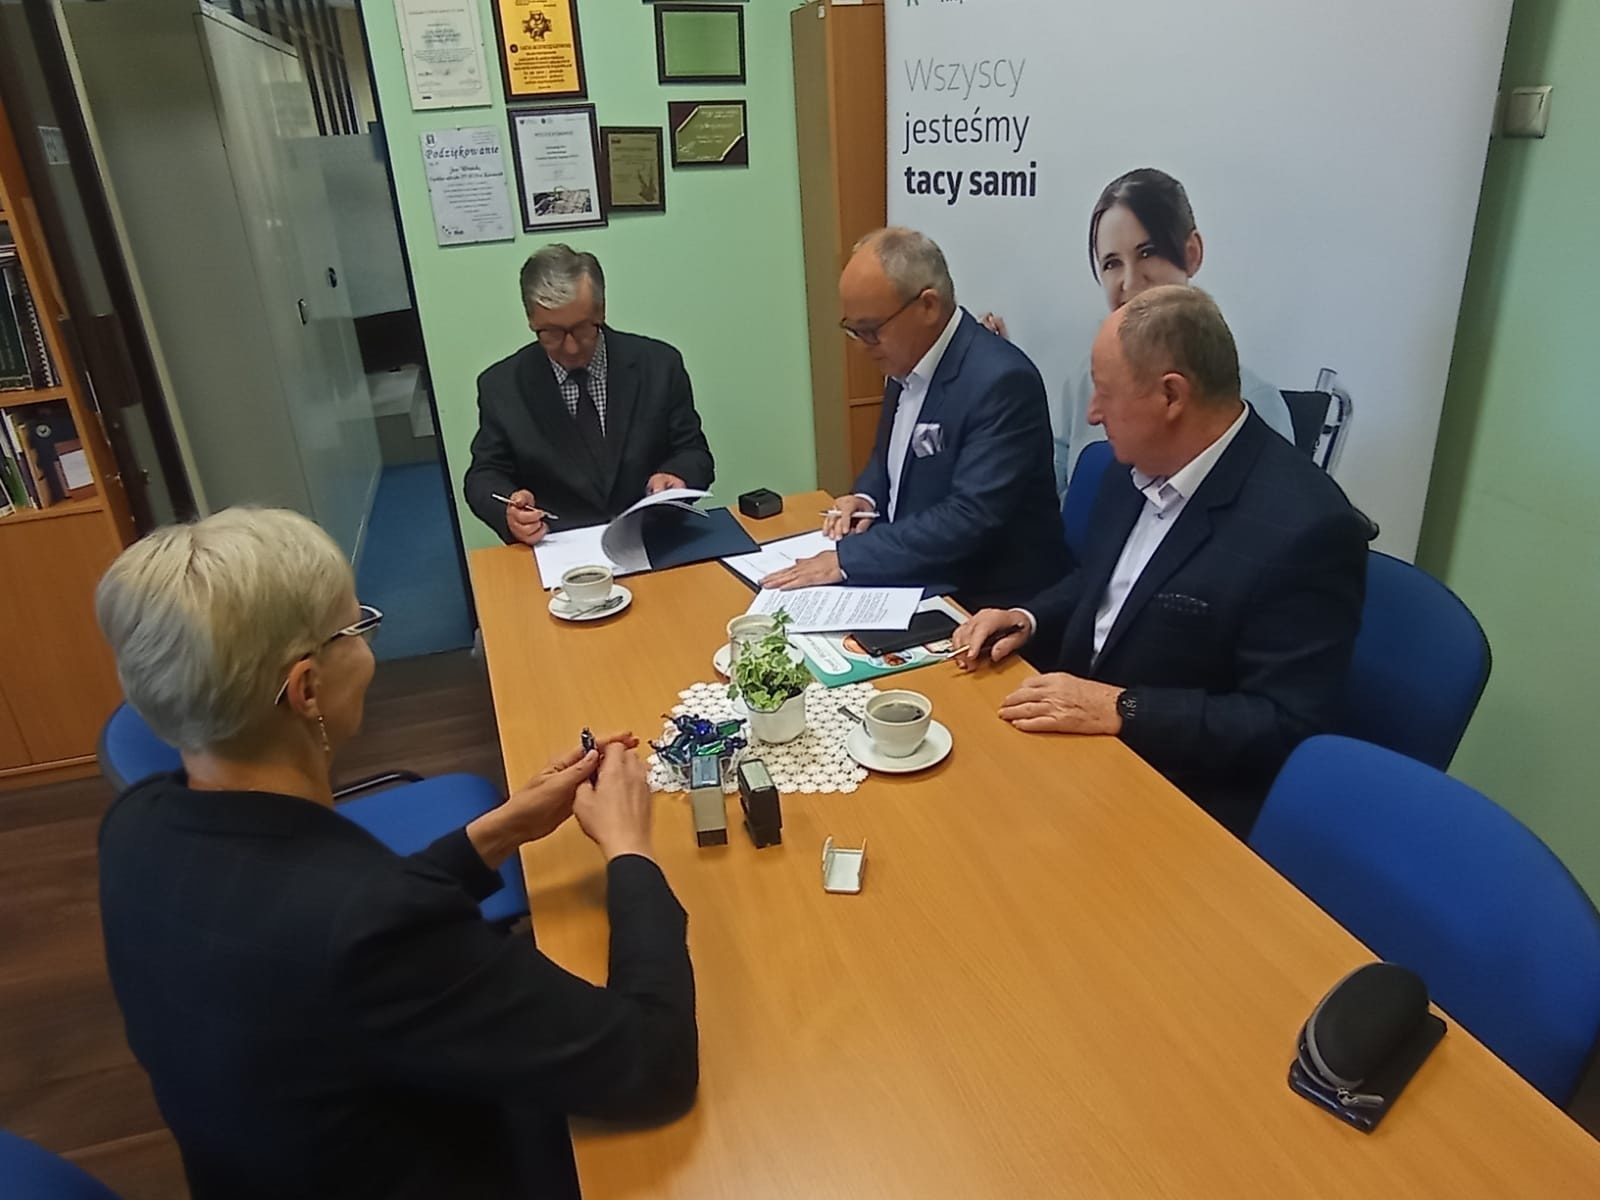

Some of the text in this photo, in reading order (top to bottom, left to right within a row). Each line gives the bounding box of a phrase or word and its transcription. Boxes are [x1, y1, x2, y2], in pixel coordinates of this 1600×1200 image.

[904, 57, 1026, 100] Wszyscy
[902, 106, 1030, 154] jesteśmy
[904, 161, 1037, 205] tacy sami
